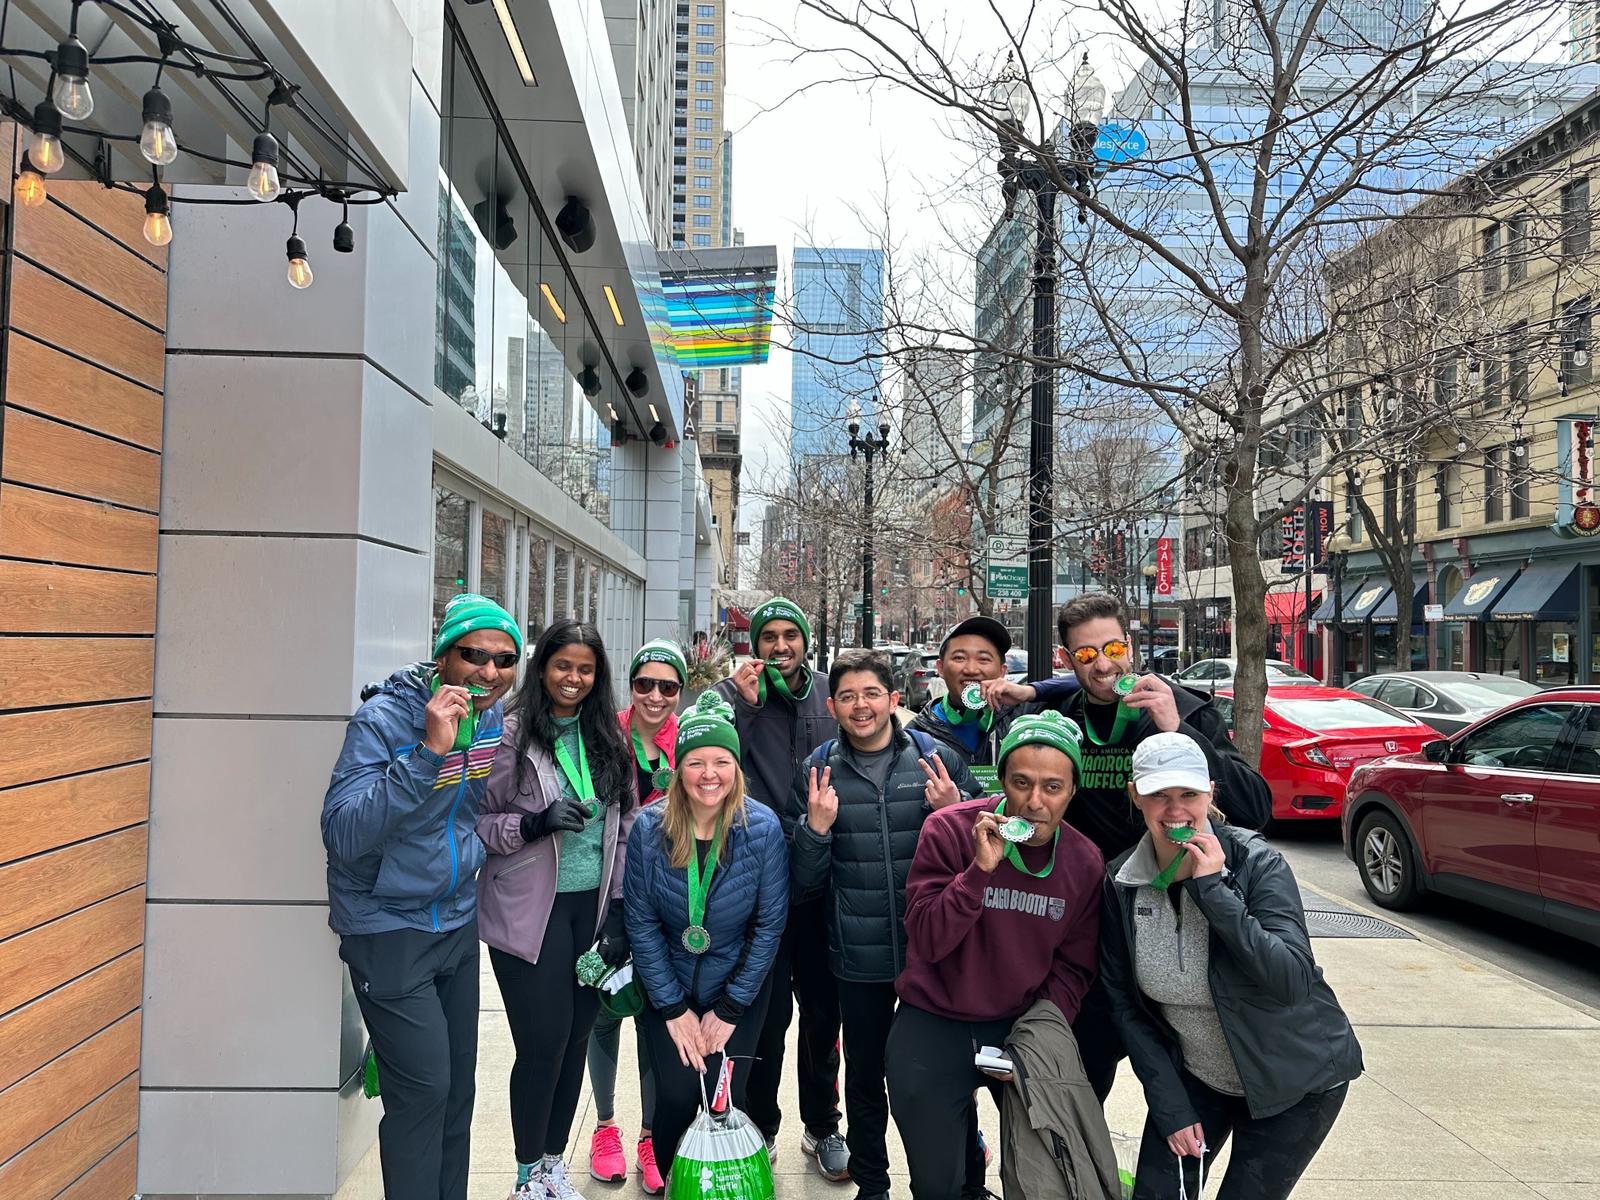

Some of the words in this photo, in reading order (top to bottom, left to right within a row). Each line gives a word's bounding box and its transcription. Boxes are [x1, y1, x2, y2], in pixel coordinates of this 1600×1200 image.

[685, 383, 696, 440] HYAT
[1281, 516, 1293, 567] RIVER
[1292, 506, 1304, 567] NORTH
[1320, 507, 1328, 532] NOW
[1160, 540, 1169, 592] JALEO
[984, 886, 1010, 910] CAGO
[1010, 889, 1048, 917] BOOTH
